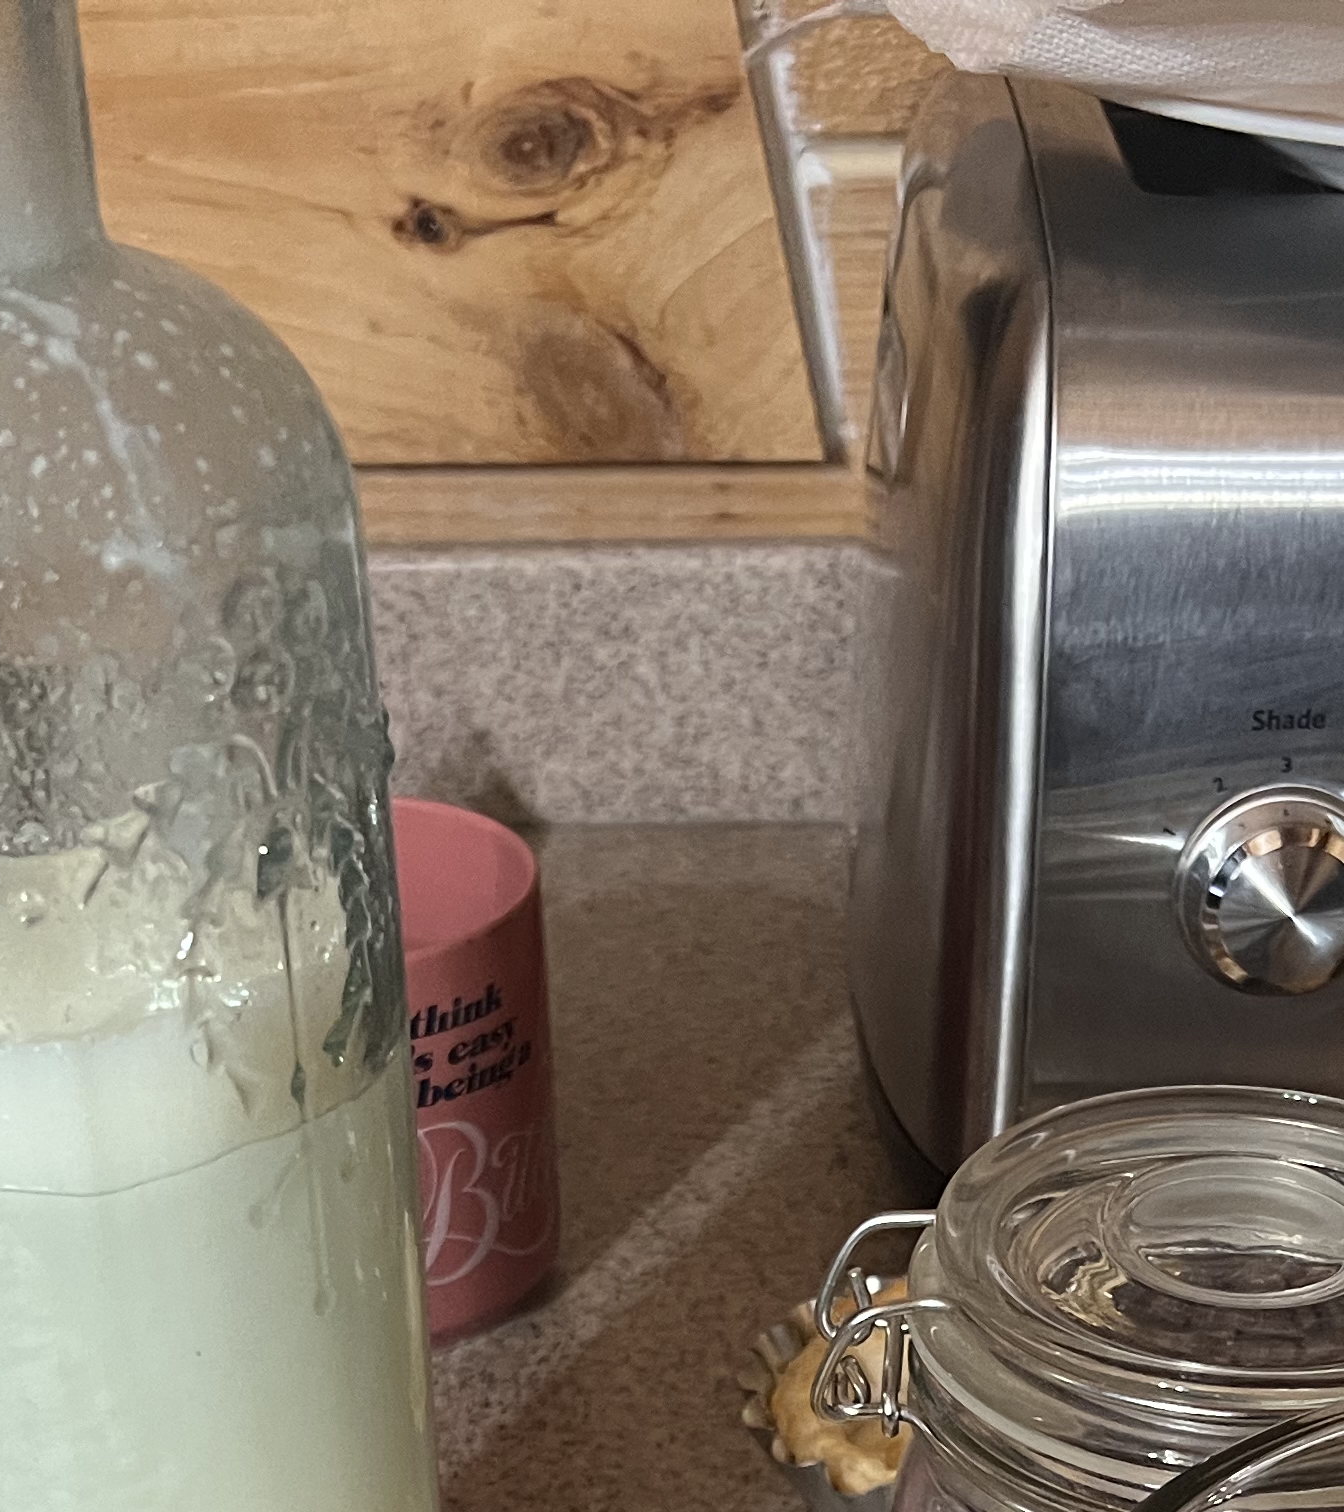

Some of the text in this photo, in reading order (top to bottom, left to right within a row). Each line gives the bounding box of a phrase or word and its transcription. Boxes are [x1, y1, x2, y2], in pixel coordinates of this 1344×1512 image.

[1249, 708, 1327, 732] Shade
[1211, 776, 1228, 793] 2
[1280, 756, 1293, 774] 3
[410, 982, 503, 1040] think
[448, 1017, 517, 1065] easy
[416, 1050, 517, 1109] being
